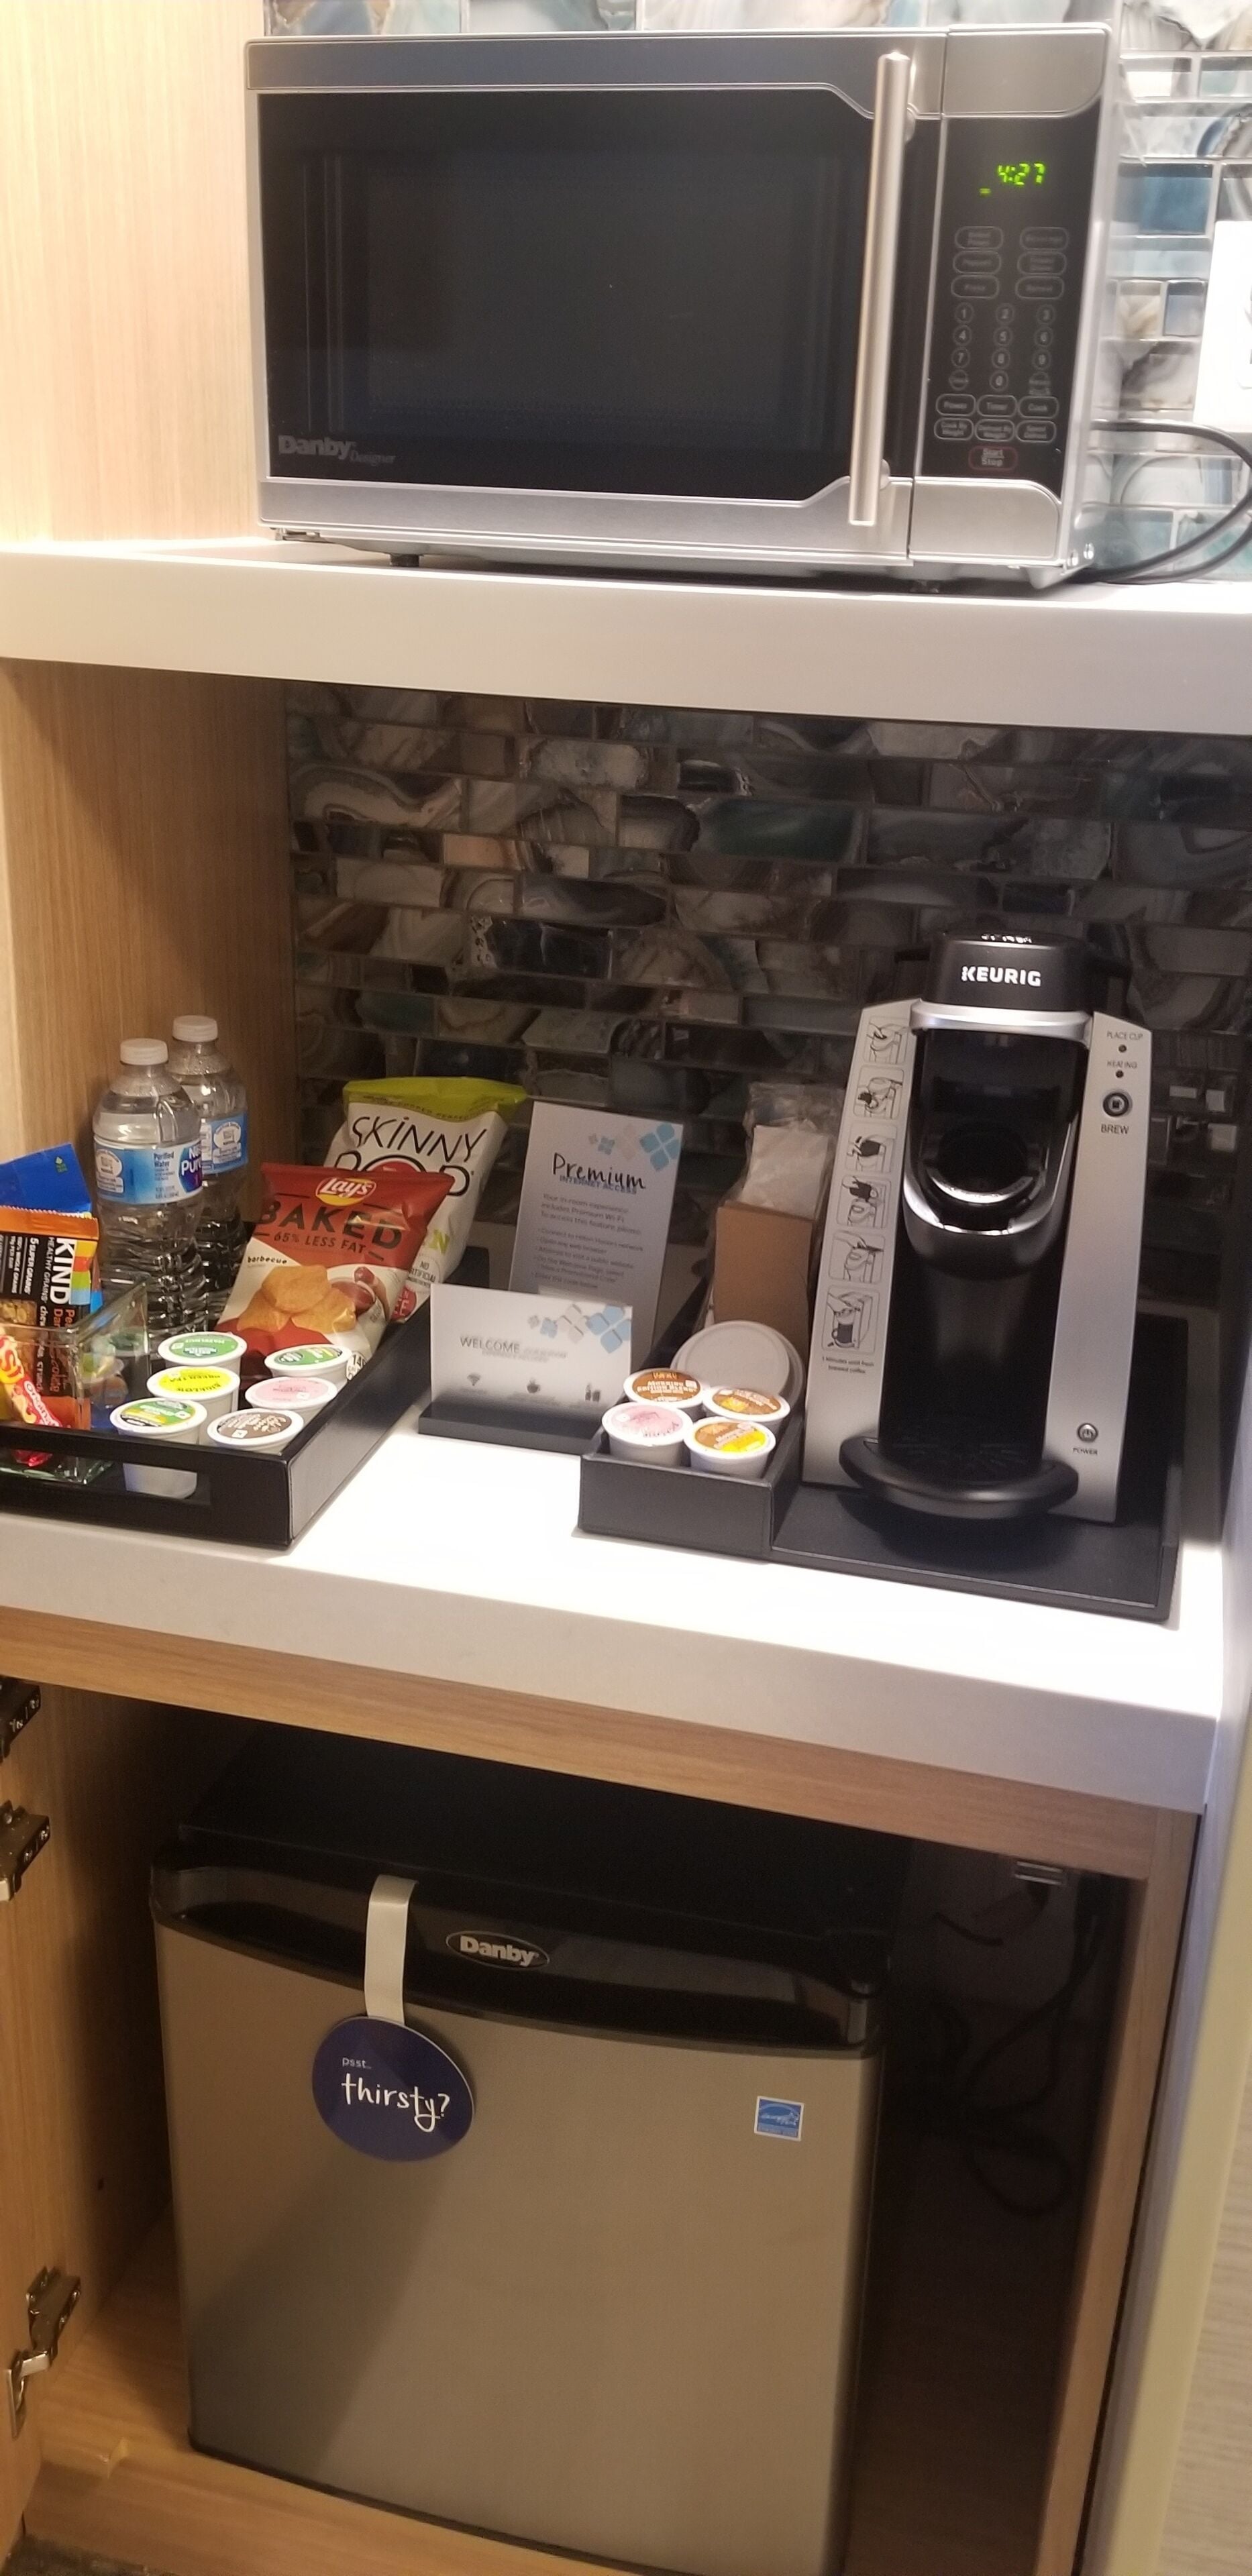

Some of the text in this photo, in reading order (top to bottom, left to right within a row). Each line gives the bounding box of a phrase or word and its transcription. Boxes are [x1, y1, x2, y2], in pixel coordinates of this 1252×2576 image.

[997, 163, 1046, 186] 4:27
[278, 435, 353, 460] Danby
[961, 966, 1041, 987] KEURIG
[1107, 1030, 1127, 1040] PLACE
[1107, 1060, 1138, 1069] HEATING
[352, 1116, 488, 1163] SKINNY
[1100, 1123, 1130, 1135] BREW
[552, 1152, 646, 1189] Premium
[260, 1199, 402, 1250] BAKED
[30, 1237, 40, 1245] 5
[274, 1232, 367, 1254] 65% LESS FAT
[28, 1245, 37, 1267] SUPER
[45, 1236, 55, 1271] HEALTHY
[247, 1255, 288, 1265] barbecue
[50, 1237, 76, 1305] KIND
[460, 1336, 521, 1354] WELCOME
[1073, 1448, 1098, 1456] POWER
[460, 1935, 539, 1966] Danby
[341, 2073, 450, 2133] thirsty?
